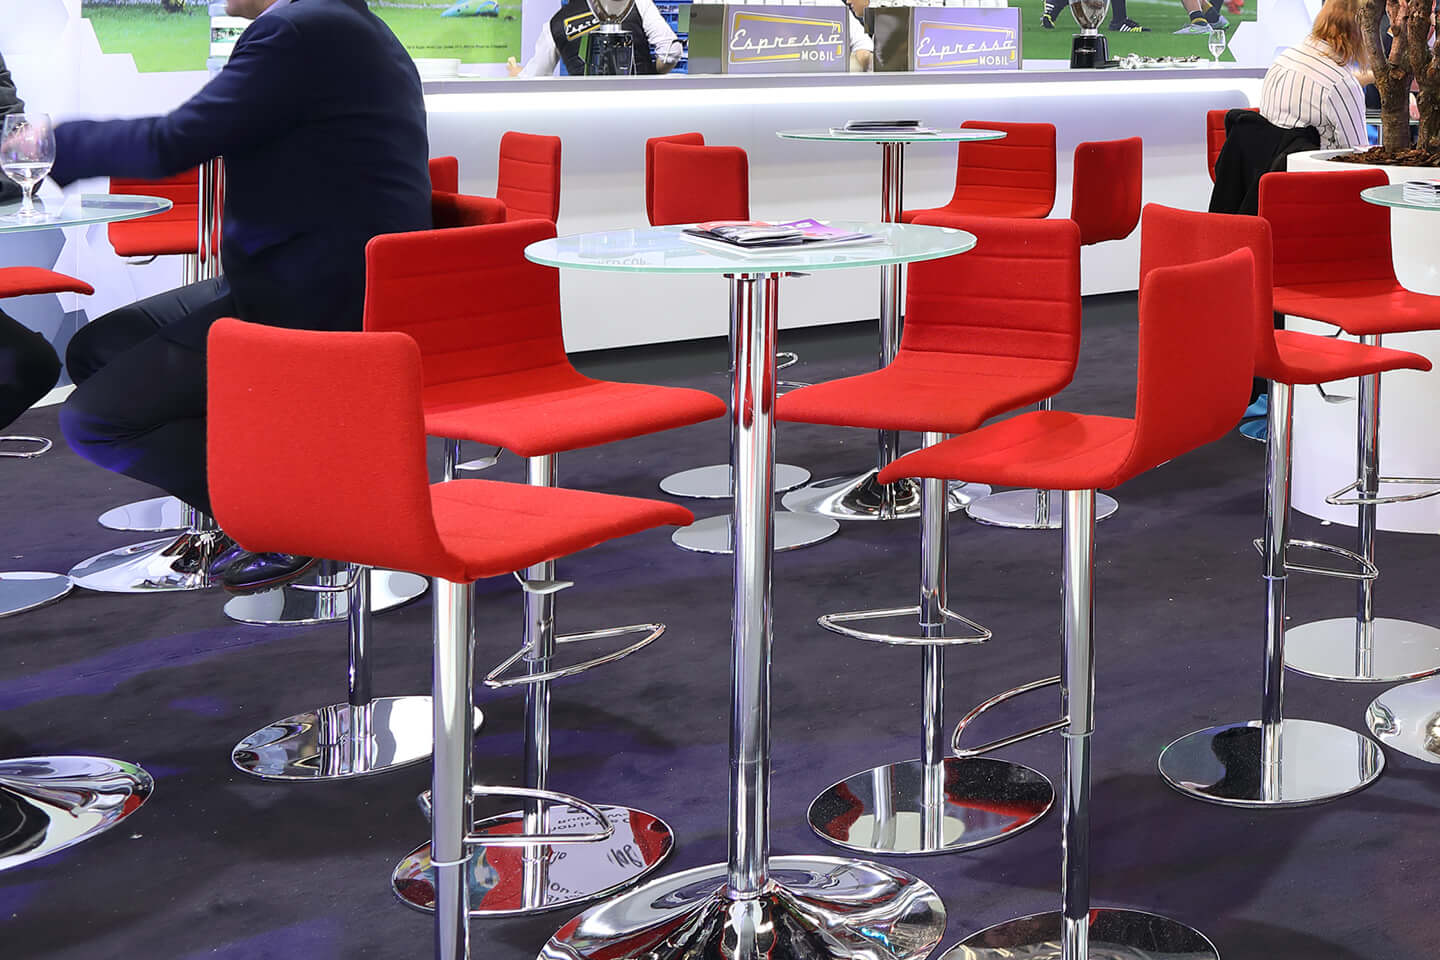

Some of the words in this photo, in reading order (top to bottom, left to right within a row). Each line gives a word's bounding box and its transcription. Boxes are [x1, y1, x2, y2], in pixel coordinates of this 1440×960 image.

[730, 29, 843, 54] Espresso
[917, 37, 1016, 60] Espresso
[801, 50, 834, 61] MOBIL
[979, 55, 1009, 65] MOBIL
